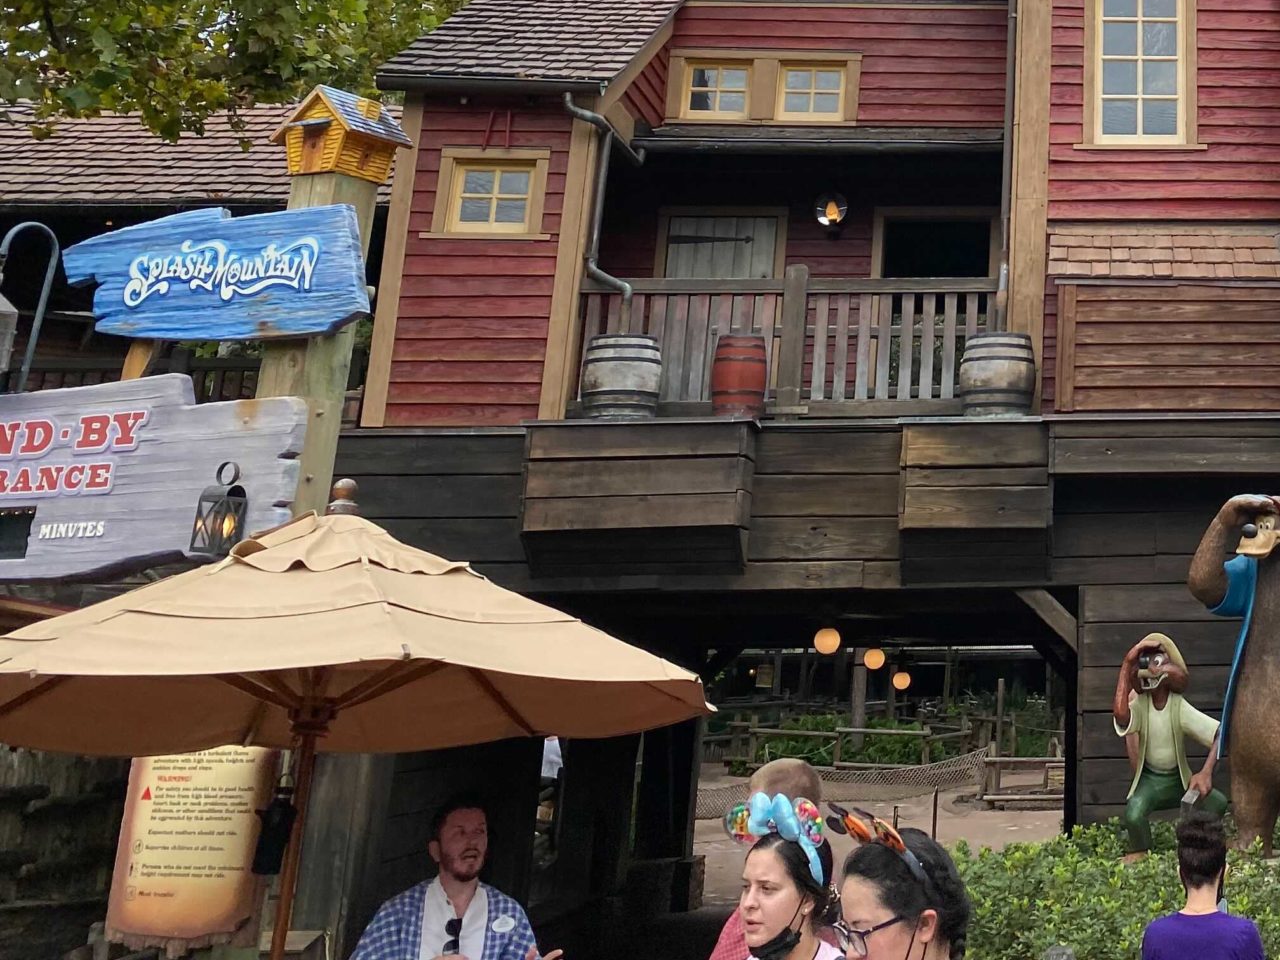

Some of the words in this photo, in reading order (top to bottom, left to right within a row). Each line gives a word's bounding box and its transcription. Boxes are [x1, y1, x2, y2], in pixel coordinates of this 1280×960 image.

[124, 250, 213, 307] SPLASH
[184, 237, 319, 301] MOUNTAIN
[38, 520, 105, 540] MINUTES
